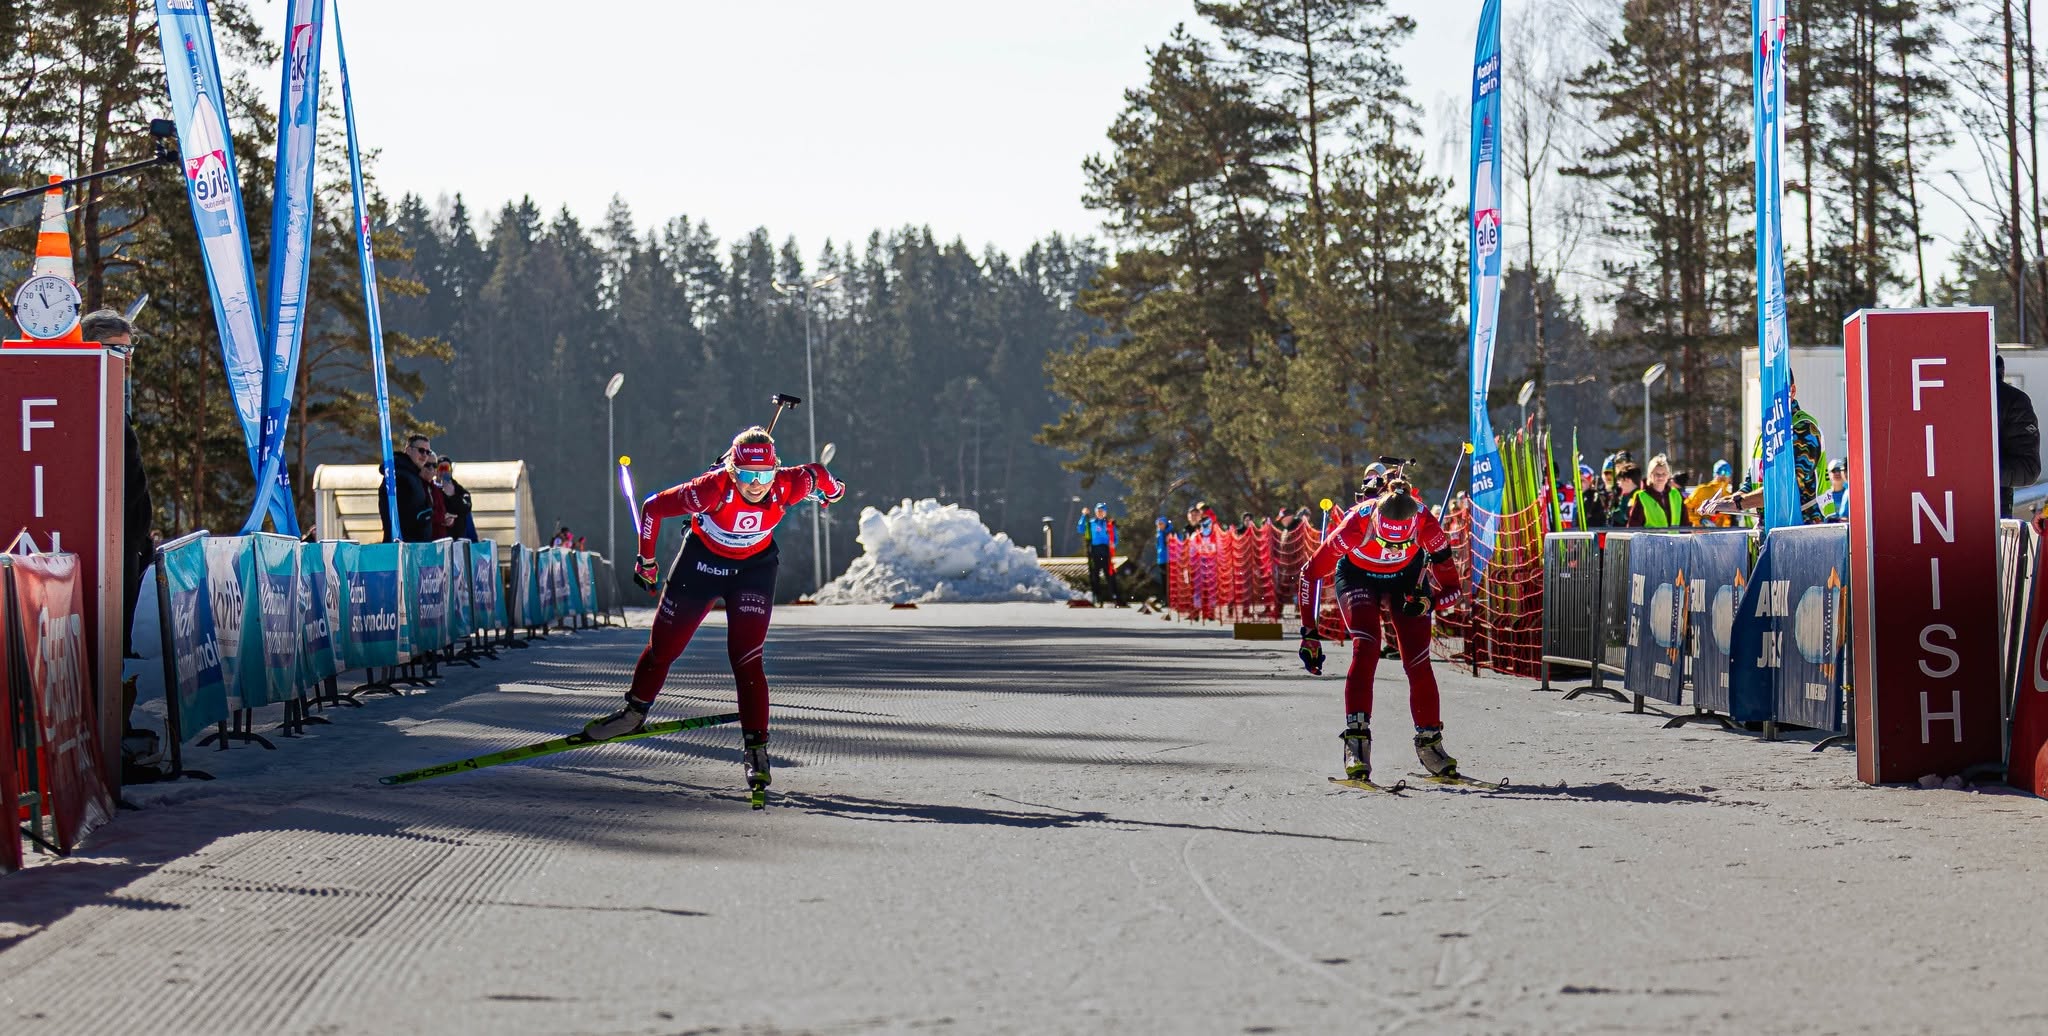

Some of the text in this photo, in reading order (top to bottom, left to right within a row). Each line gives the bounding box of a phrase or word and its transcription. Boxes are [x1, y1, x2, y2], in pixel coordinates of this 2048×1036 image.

[642, 512, 654, 540] JETOIL
[1381, 522, 1402, 531] Mobil
[1911, 358, 1962, 744] FINISH
[696, 561, 729, 576] Mobil
[1301, 579, 1311, 606] JETOIL
